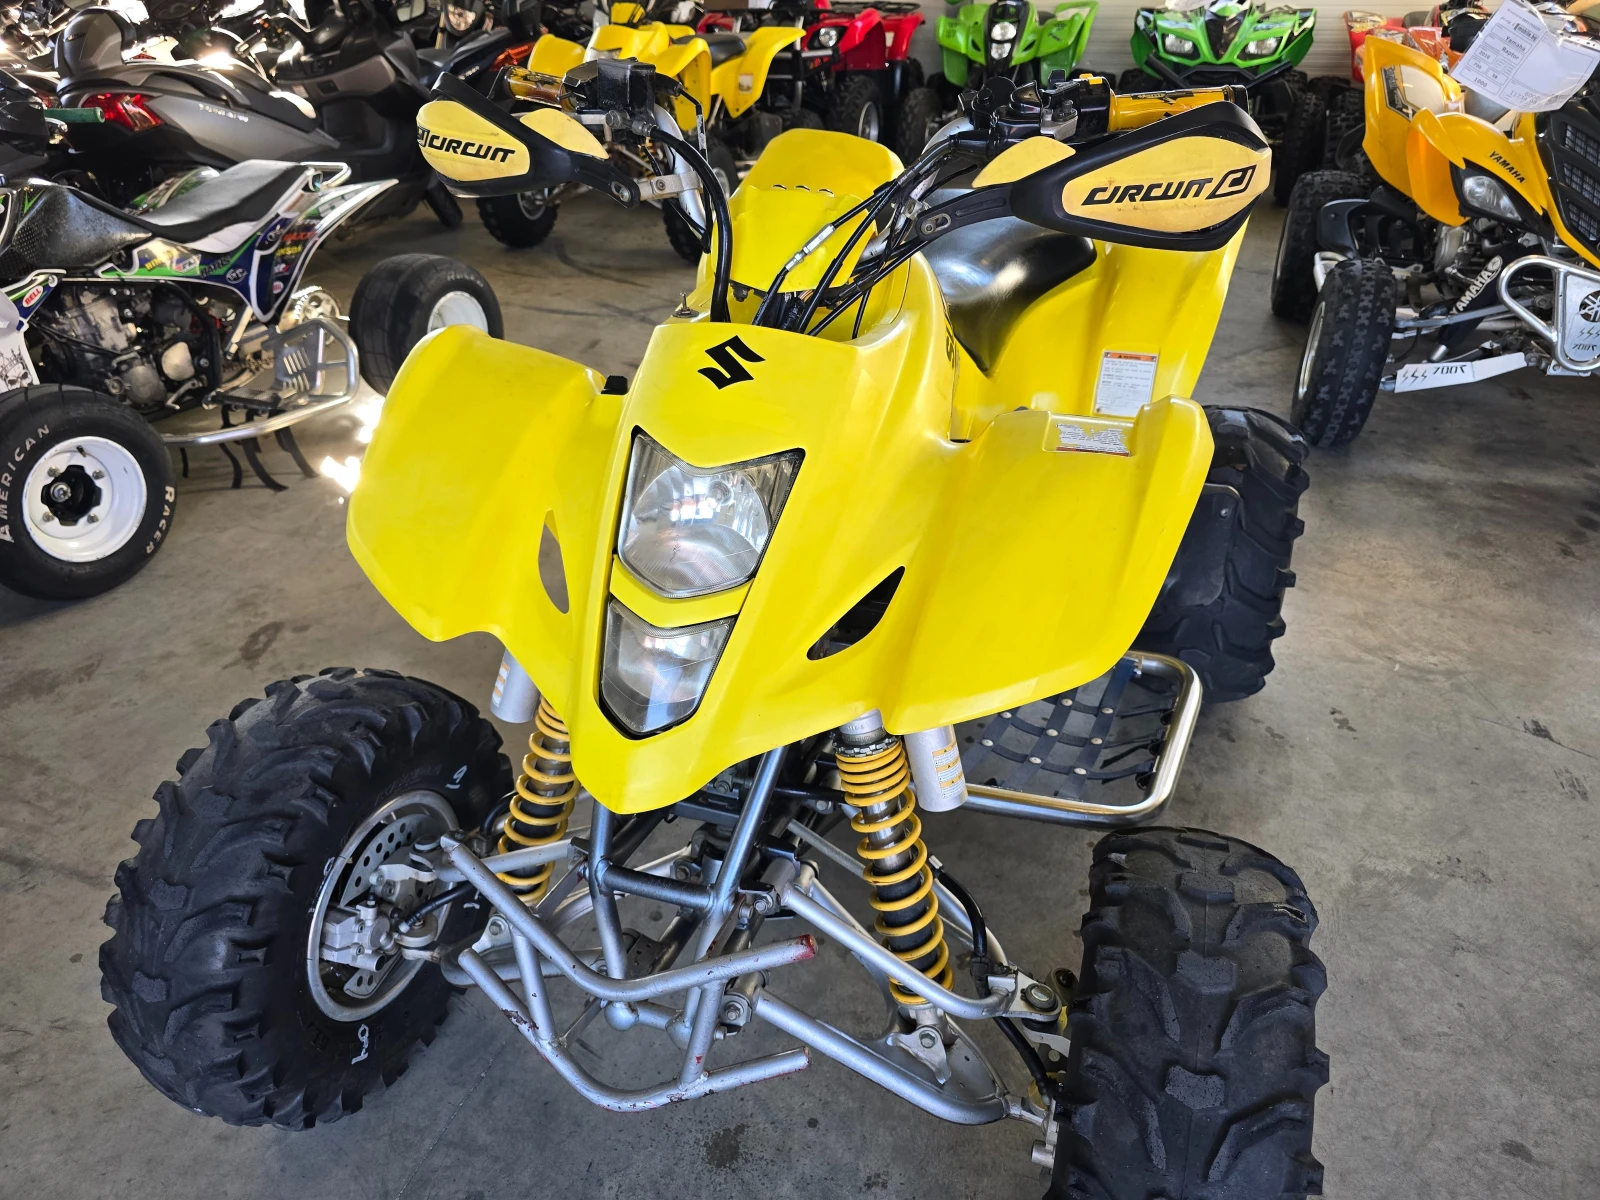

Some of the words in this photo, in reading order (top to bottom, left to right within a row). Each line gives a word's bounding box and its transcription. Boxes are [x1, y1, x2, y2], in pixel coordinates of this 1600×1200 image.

[1501, 46, 1520, 60] Raptor
[1505, 36, 1526, 52] Yamaha
[427, 134, 516, 163] CIRCUIT
[1489, 150, 1526, 183] YAMAHA
[1081, 177, 1214, 206] CIRCUIT
[24, 288, 42, 305] BELL
[1449, 270, 1493, 315] YAMAHA
[0, 424, 51, 544] AMERICAN
[146, 485, 175, 554] RACER
